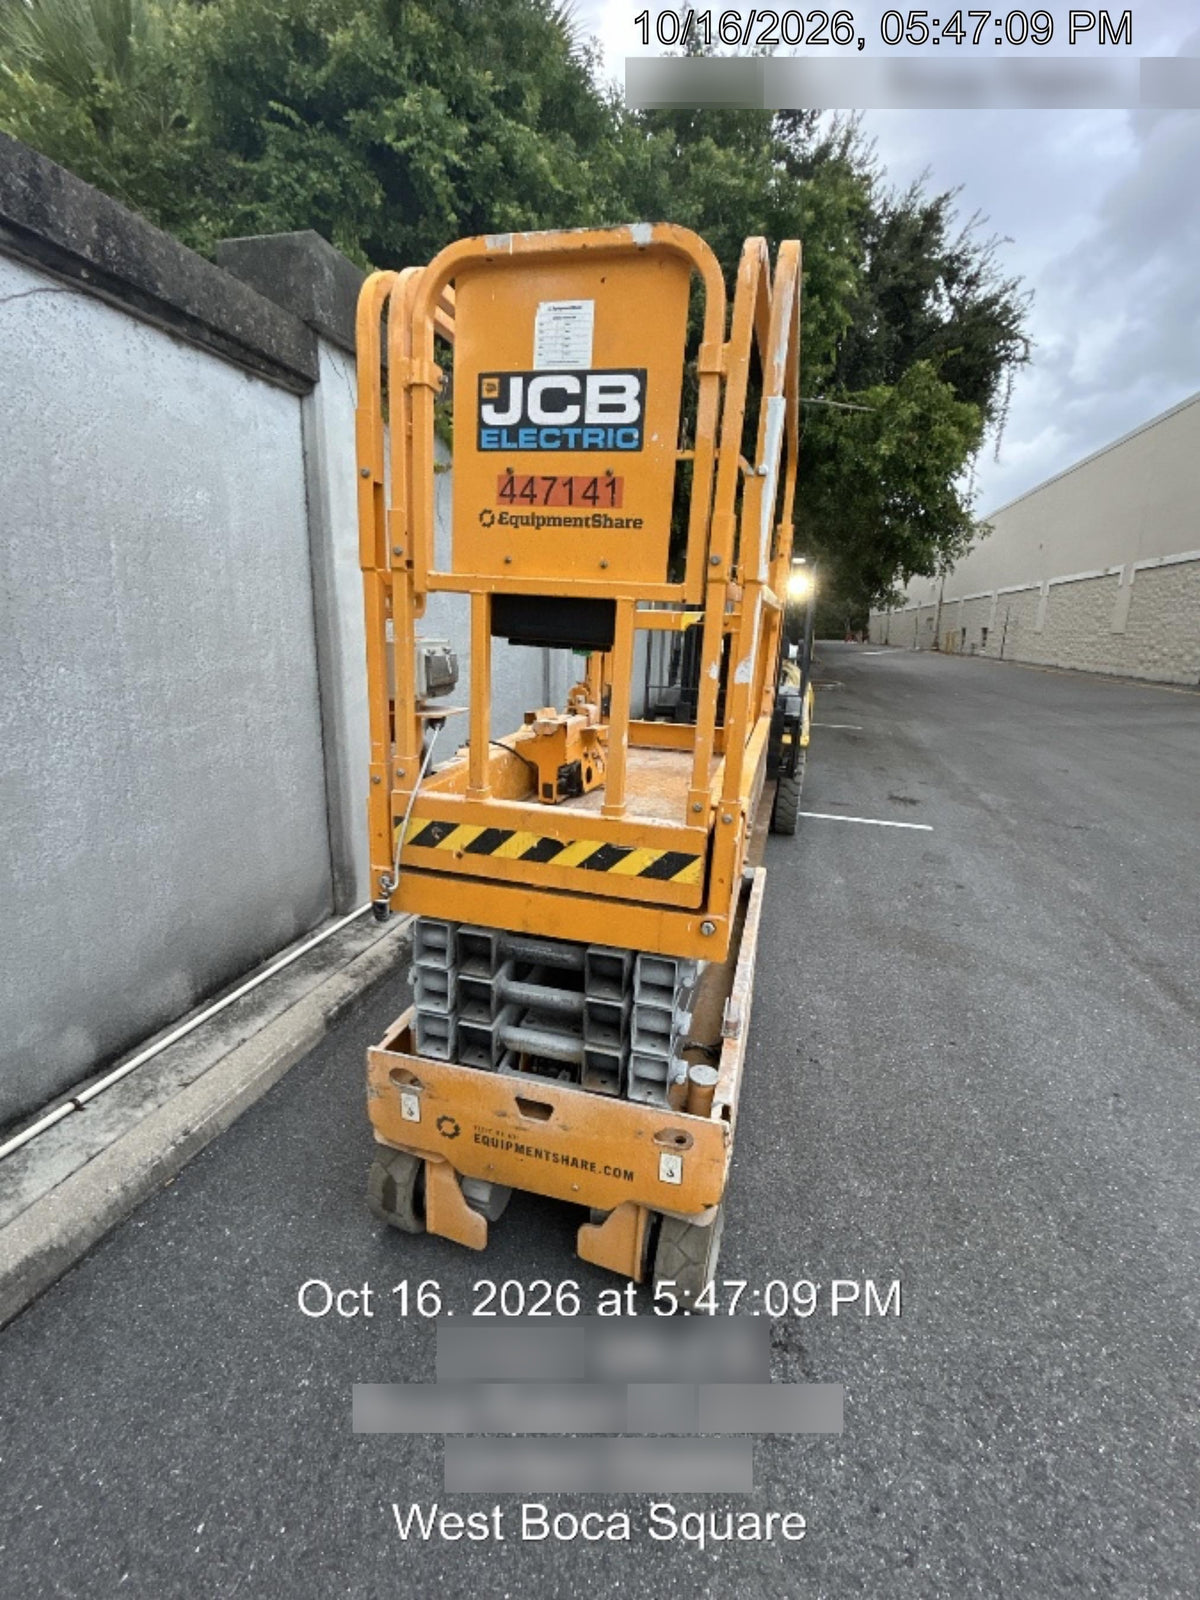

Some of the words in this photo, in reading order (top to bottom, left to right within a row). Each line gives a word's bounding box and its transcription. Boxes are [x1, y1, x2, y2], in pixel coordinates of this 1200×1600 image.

[481, 374, 641, 426] JCB
[481, 428, 639, 449] ELECTRIC
[499, 475, 617, 507] 447141
[497, 511, 643, 530] EquipmentShare
[474, 1132, 635, 1182] EQUIPMENTSHARE.COM
